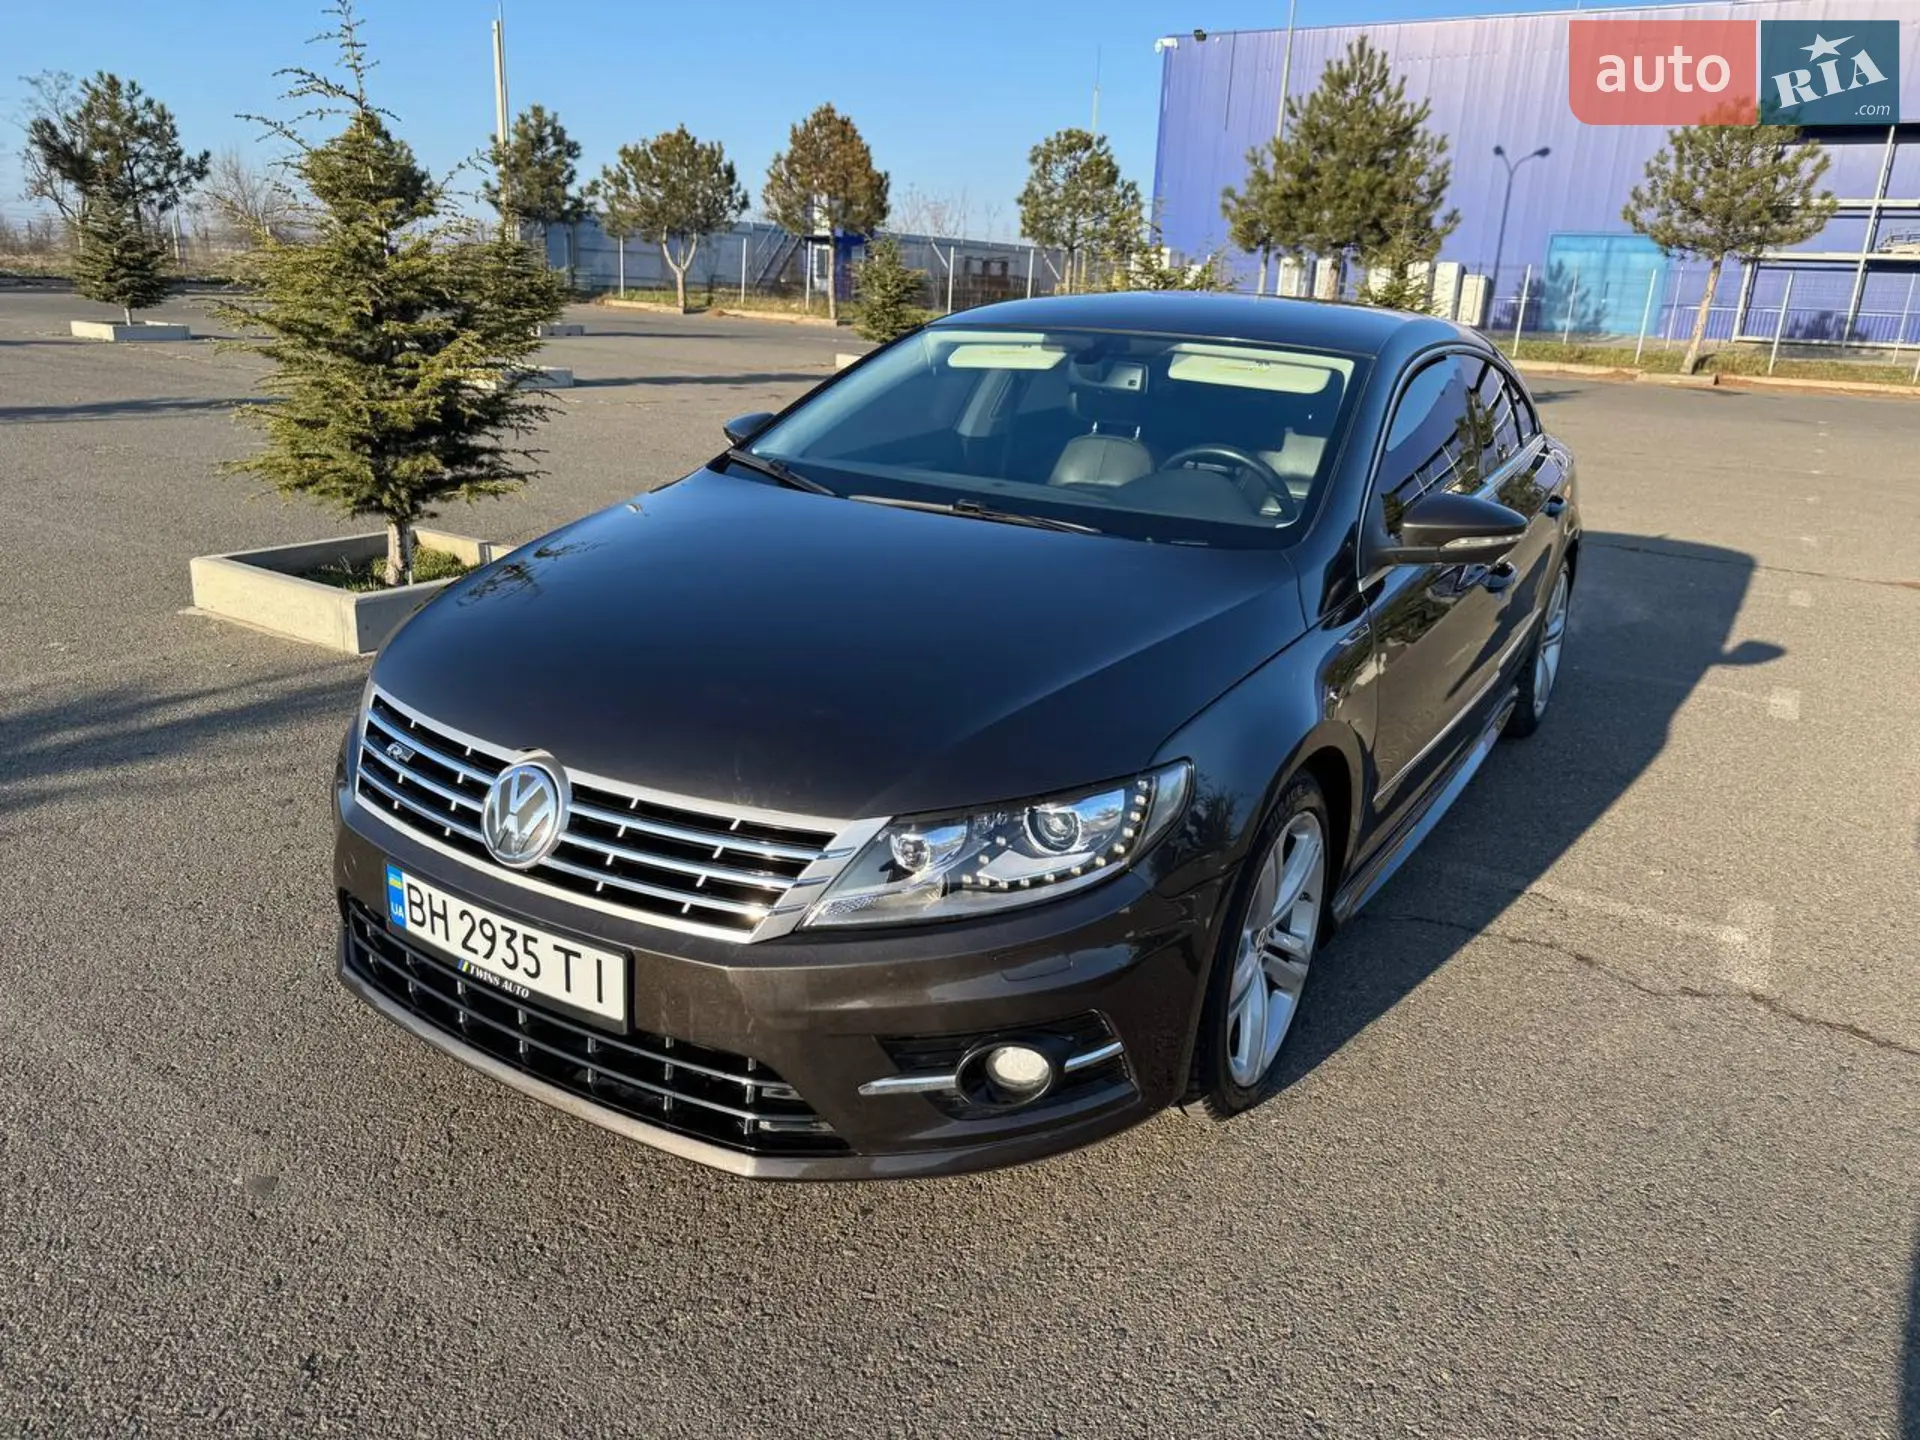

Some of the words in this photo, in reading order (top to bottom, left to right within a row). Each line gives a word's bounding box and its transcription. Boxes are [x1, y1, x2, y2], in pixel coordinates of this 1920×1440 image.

[390, 902, 405, 919] UA
[406, 882, 449, 942] BH
[459, 909, 541, 979] 2935
[469, 964, 500, 985] TWINS
[502, 980, 530, 998] AUTO
